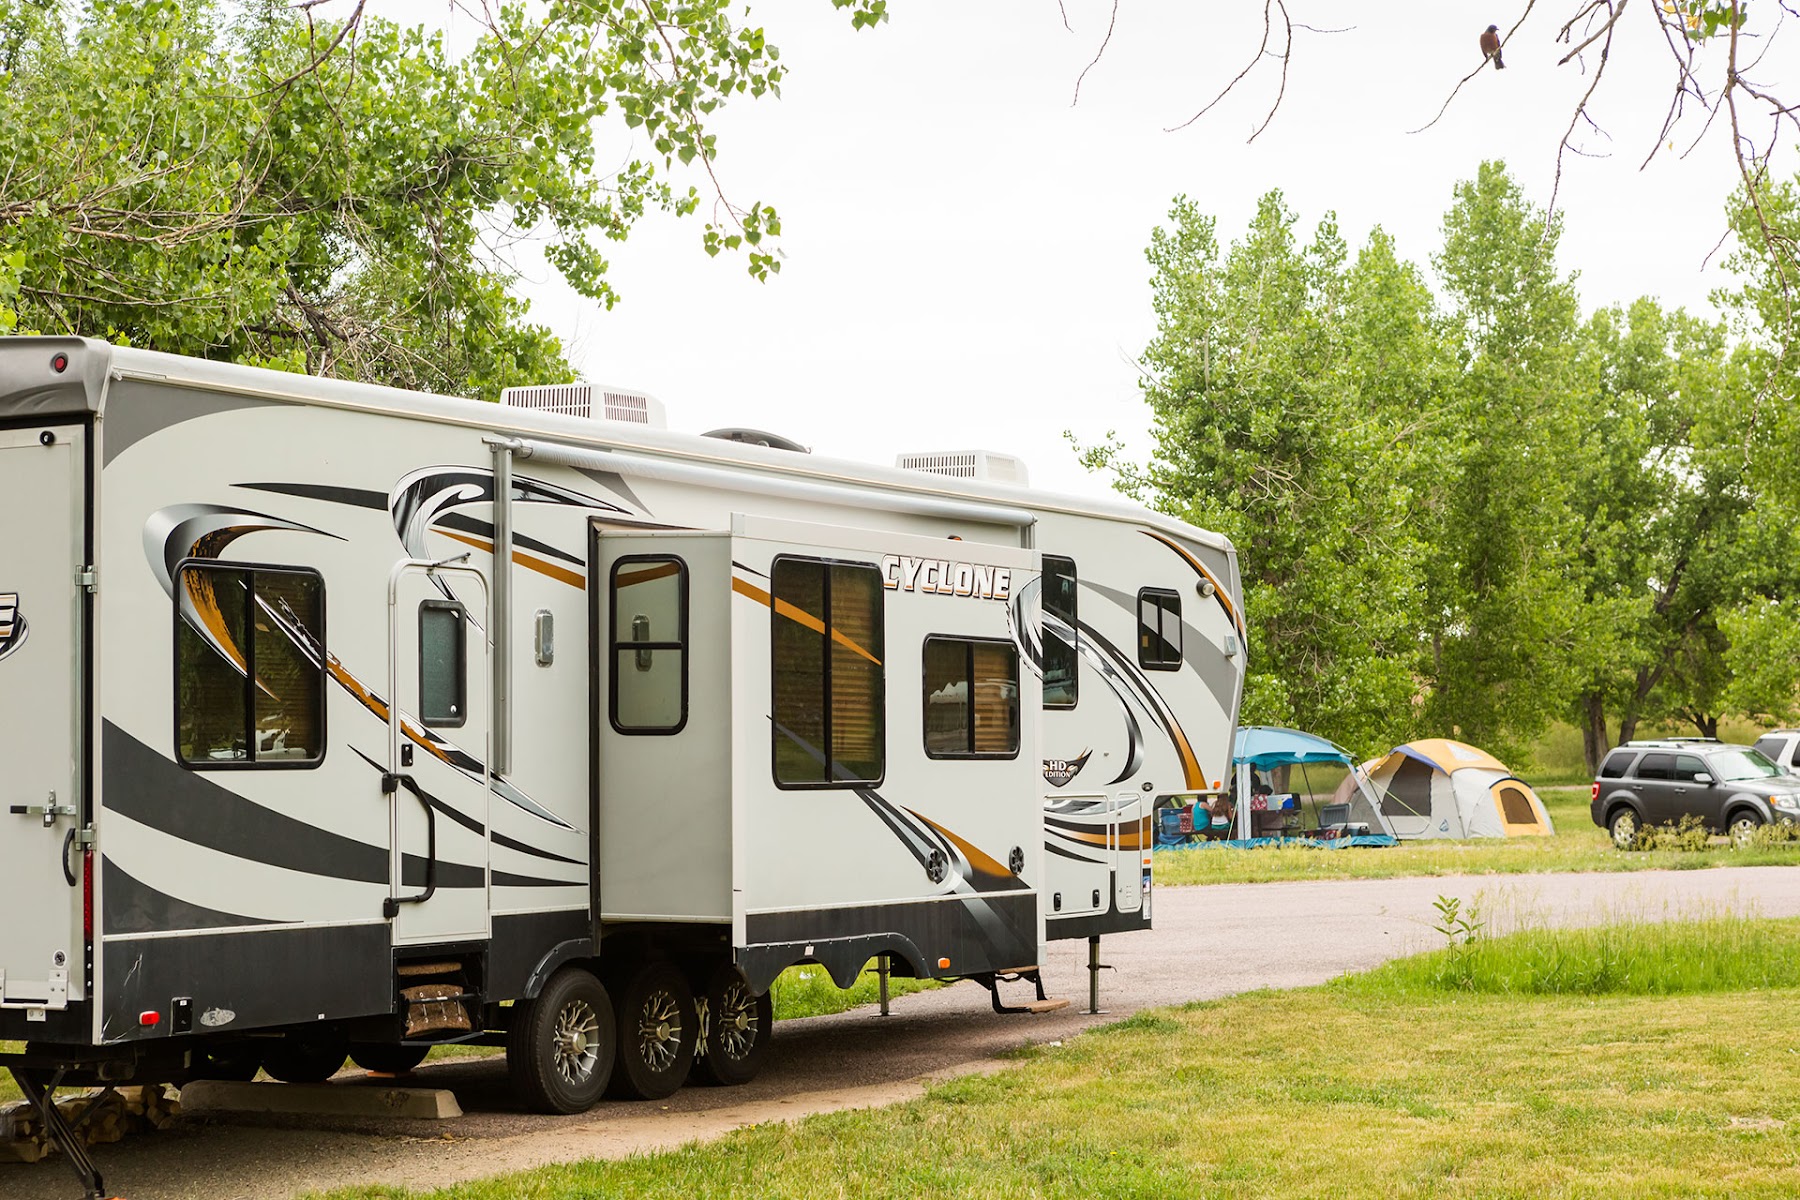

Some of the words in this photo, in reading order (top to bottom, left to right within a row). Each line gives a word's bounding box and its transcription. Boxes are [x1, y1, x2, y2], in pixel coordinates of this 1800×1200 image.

[882, 554, 1011, 600] CYCLONE
[1049, 760, 1067, 771] HD
[1045, 770, 1070, 778] EDITION
